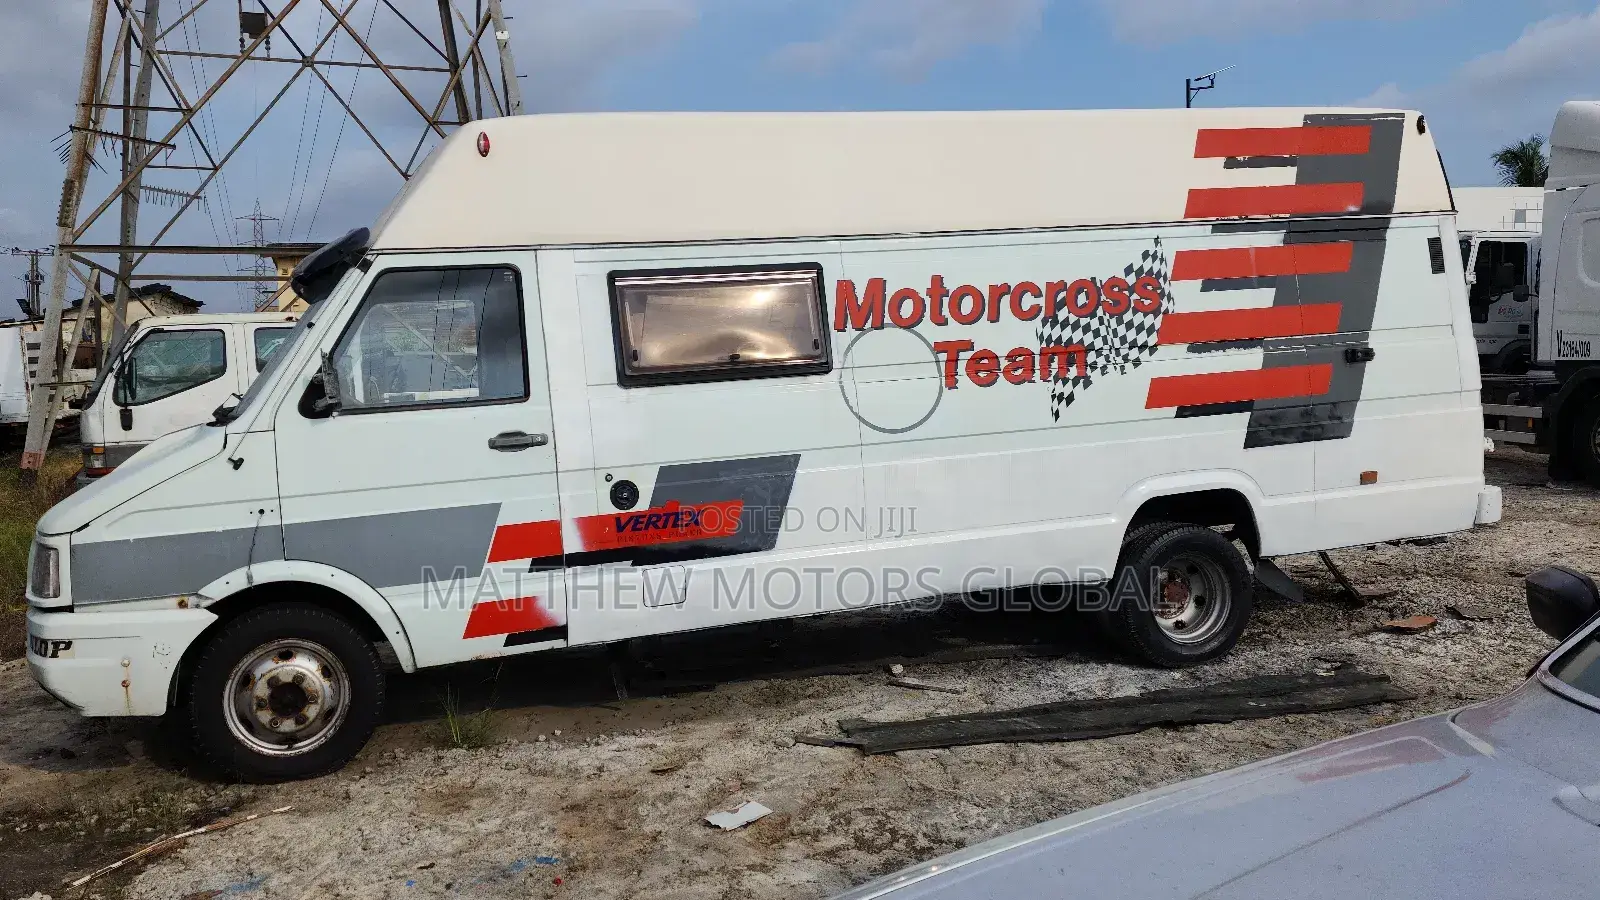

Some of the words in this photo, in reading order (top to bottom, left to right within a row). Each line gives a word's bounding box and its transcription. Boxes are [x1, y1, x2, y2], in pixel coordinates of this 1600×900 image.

[833, 274, 1163, 332] Motorcross
[934, 338, 1089, 390] Team
[615, 509, 705, 534] VERTEX
